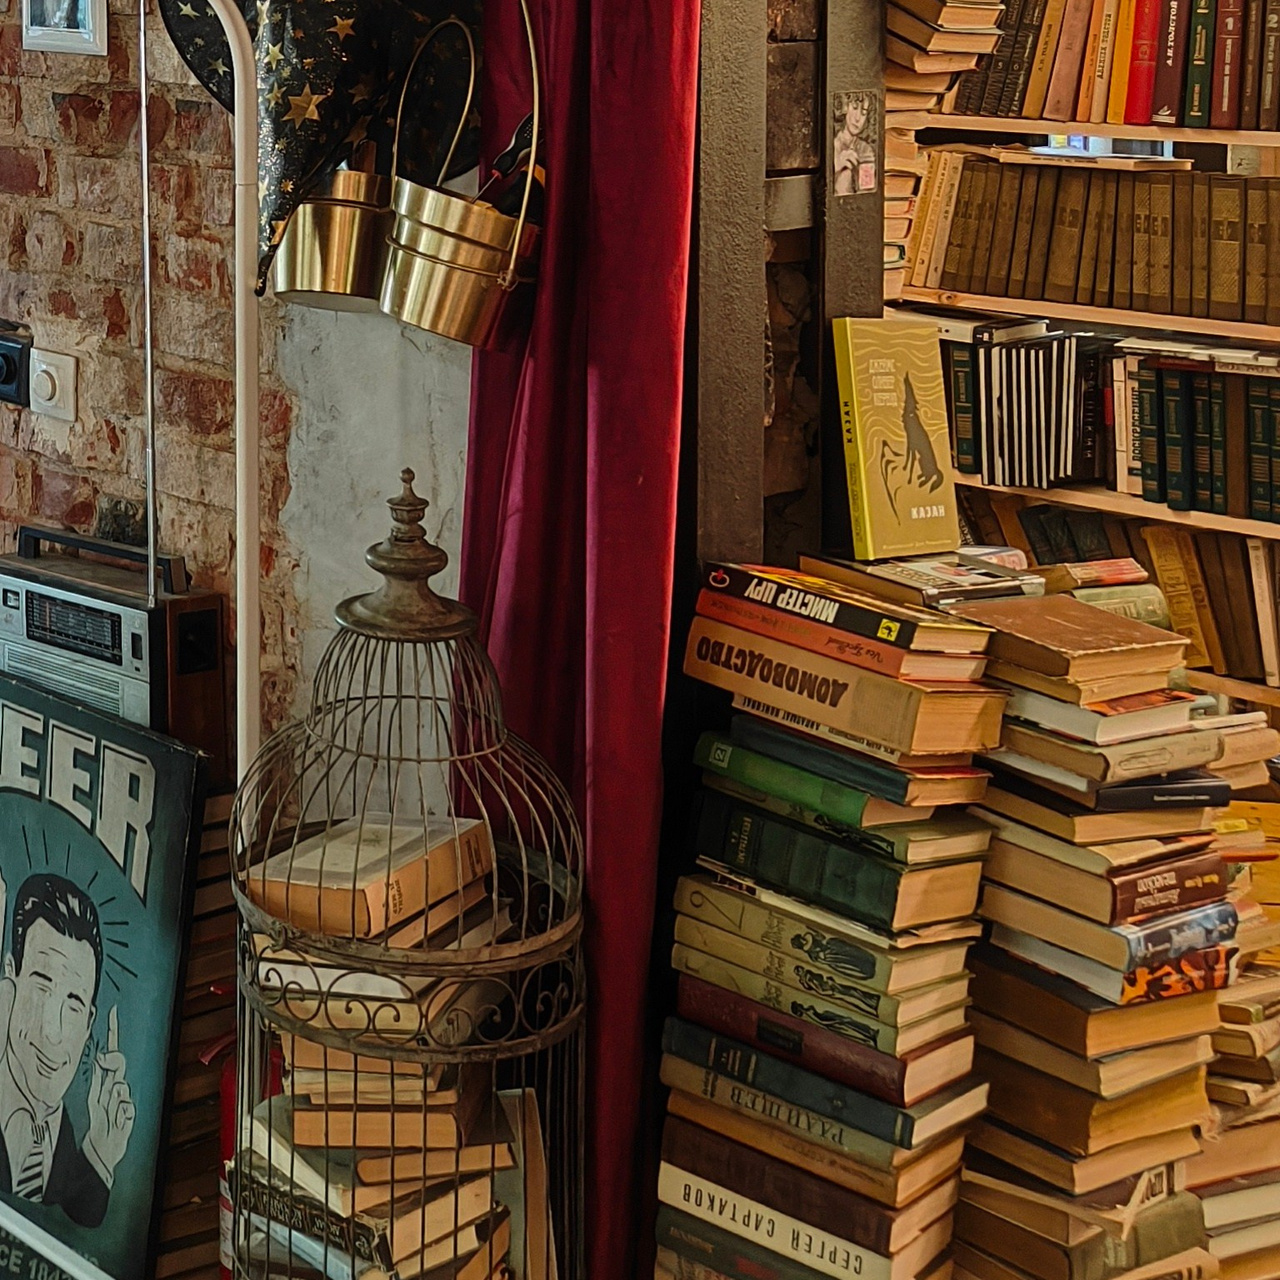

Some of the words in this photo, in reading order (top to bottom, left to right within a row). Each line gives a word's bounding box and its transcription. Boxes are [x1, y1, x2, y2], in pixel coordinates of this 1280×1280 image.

[1225, 17, 1233, 31] 1
[1267, 14, 1278, 28] 2
[843, 401, 853, 444] КАЗАН
[911, 505, 945, 520] КАЗАН
[744, 578, 778, 603] ЦРУ
[776, 586, 839, 624] МИСТЕР
[696, 635, 849, 708] ДОМОВОДСТВО
[683, 1183, 776, 1238] САРТАКОВ
[790, 1228, 863, 1275] СЕРГЕЙ
